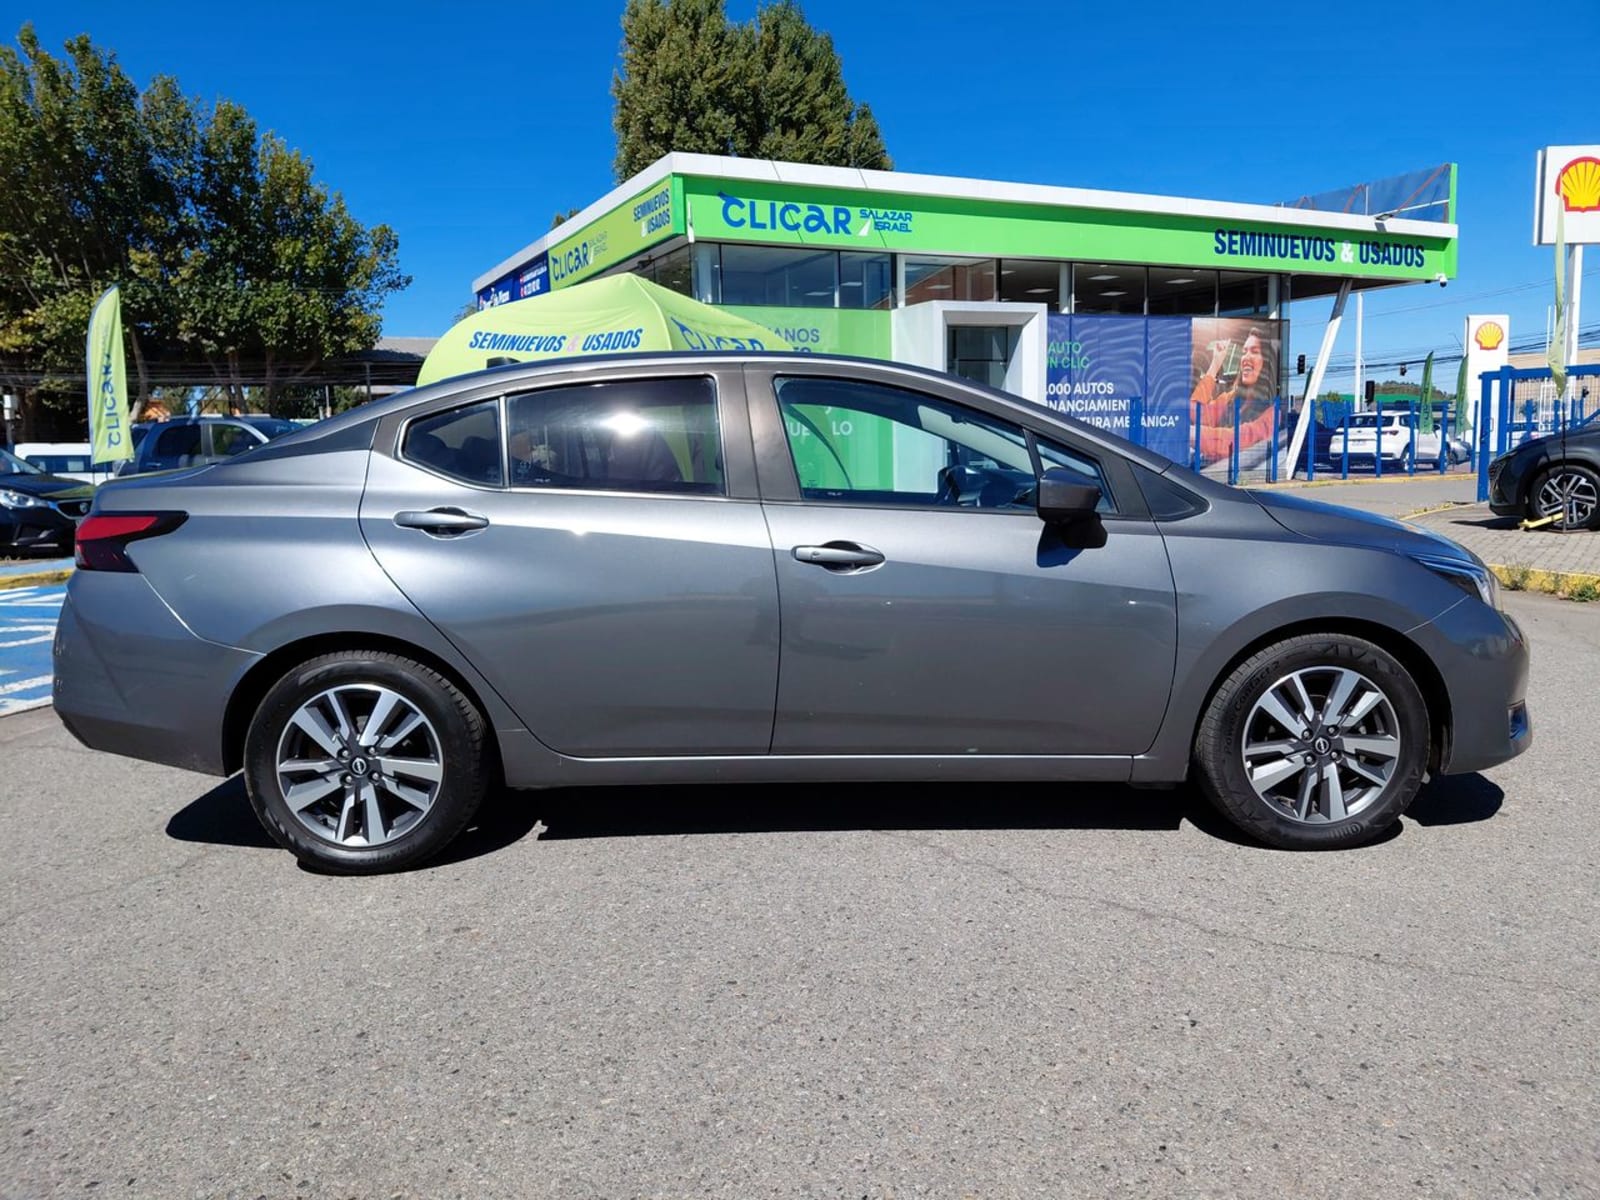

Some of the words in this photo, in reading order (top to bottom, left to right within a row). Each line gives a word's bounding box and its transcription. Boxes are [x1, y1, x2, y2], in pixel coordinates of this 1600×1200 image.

[860, 209, 912, 222] SALAZAR
[874, 221, 912, 232] ISRAEL
[1214, 229, 1335, 262] SEMINUEVOS
[1341, 240, 1354, 263] &
[1359, 240, 1425, 267] USADOS
[469, 331, 566, 352] SEMINUEVOS
[582, 328, 643, 351] USADOS
[768, 327, 820, 343] ANOS
[1048, 341, 1082, 354] AUTO
[1047, 357, 1057, 368] N
[1062, 356, 1090, 368] CLIC
[1074, 382, 1114, 395] AUTOS
[1113, 412, 1179, 428] MEÁNICA
[832, 420, 853, 436] LO
